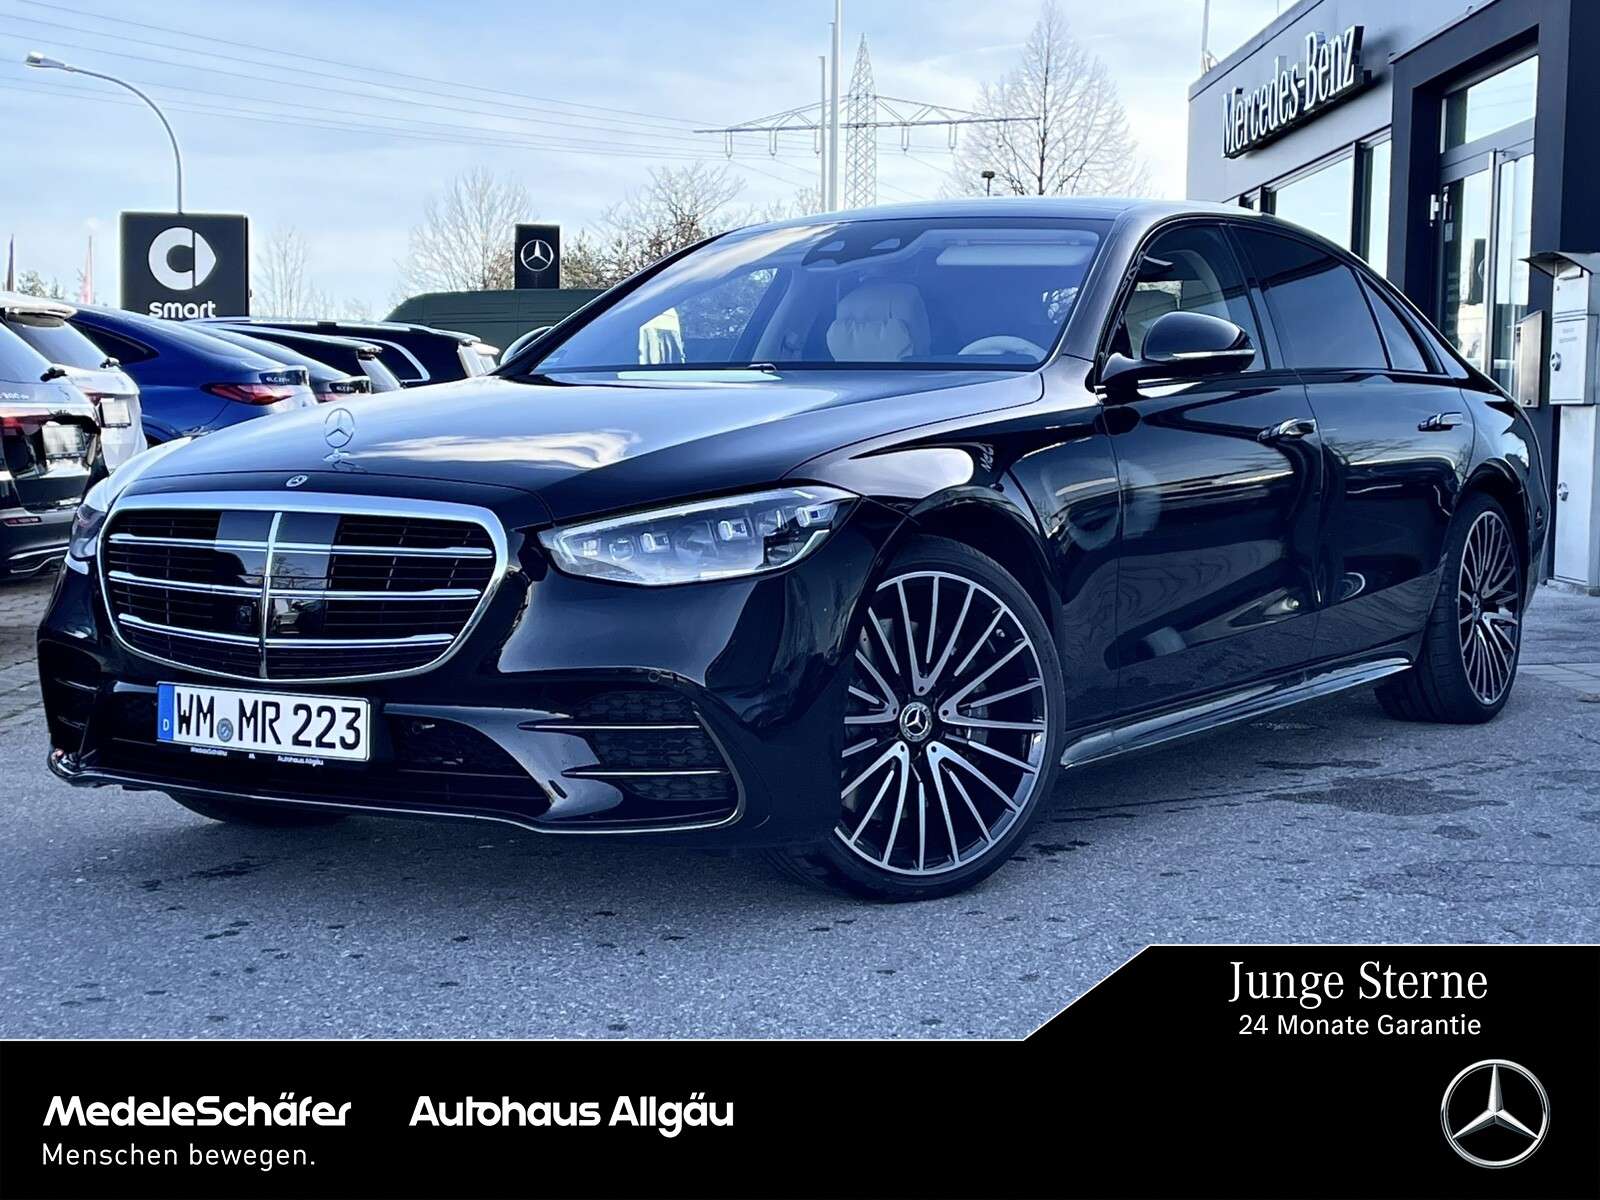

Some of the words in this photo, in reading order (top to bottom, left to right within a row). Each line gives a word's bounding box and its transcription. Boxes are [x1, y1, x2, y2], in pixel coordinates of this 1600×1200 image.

[1222, 25, 1357, 157] Mercedes-Benz
[148, 300, 217, 319] smart
[162, 719, 170, 732] D
[176, 692, 215, 738] WM
[238, 698, 282, 745] MR
[291, 703, 362, 750] 223
